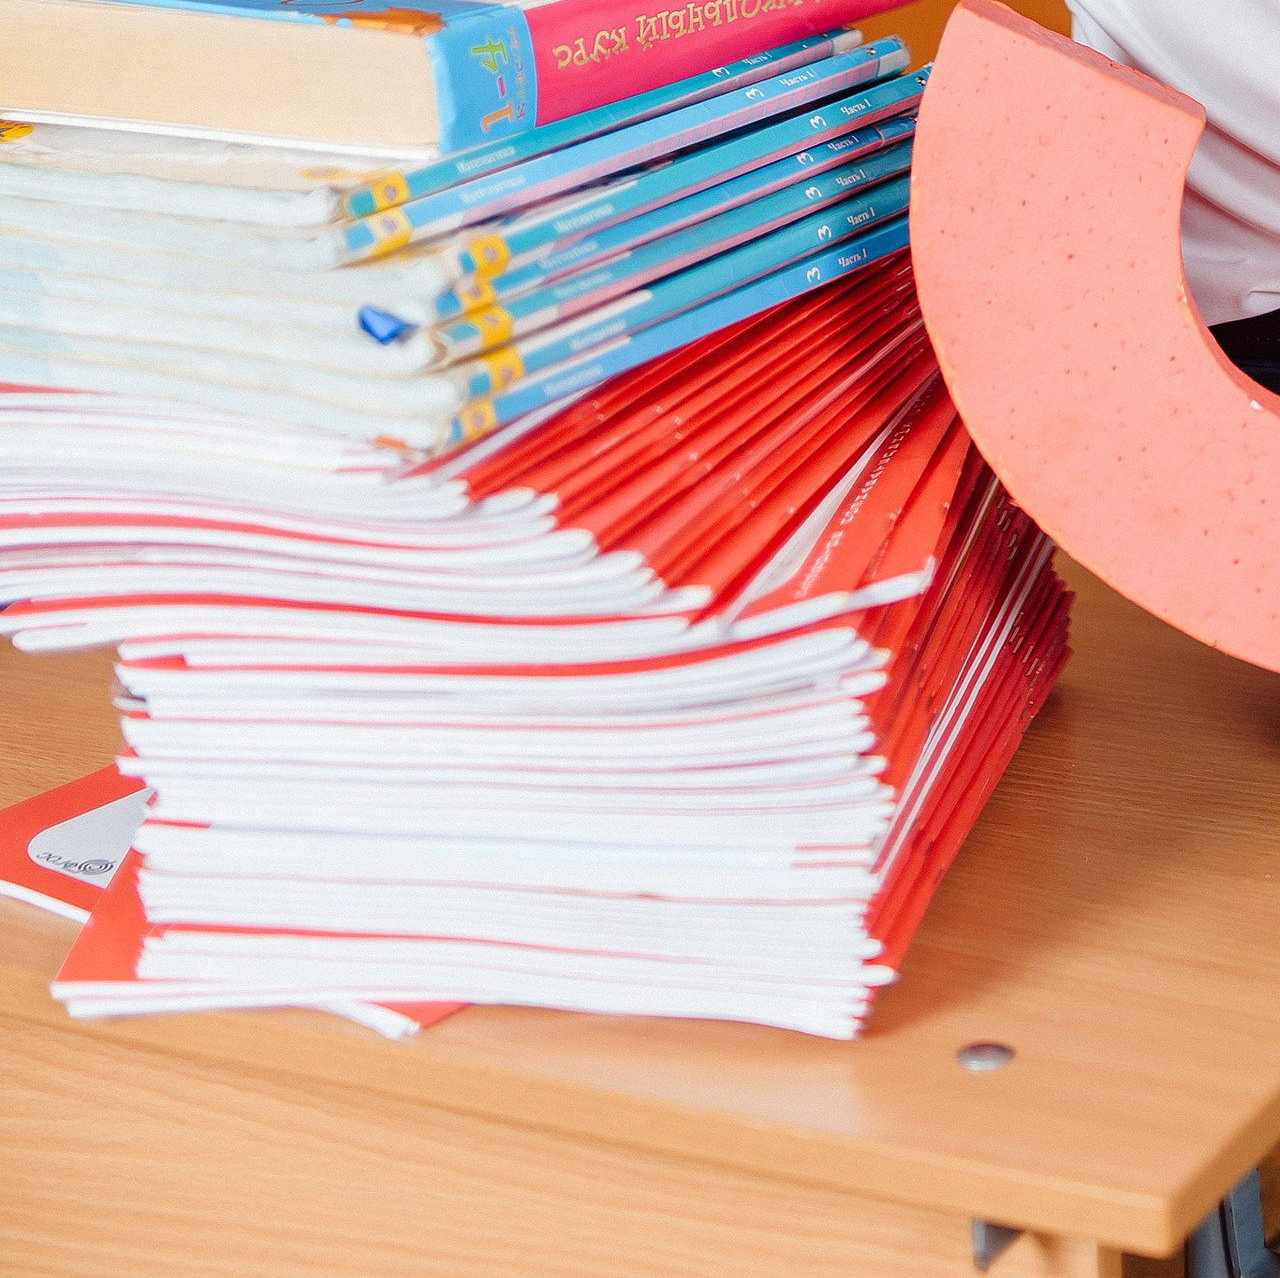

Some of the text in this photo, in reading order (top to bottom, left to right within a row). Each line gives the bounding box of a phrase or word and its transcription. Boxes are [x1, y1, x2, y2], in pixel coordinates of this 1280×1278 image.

[552, 25, 629, 70] КУРС
[780, 73, 808, 87] Часть
[840, 102, 866, 115] Часть
[828, 140, 853, 152] Часть
[836, 173, 861, 187] Часть
[847, 211, 870, 226] Часть
[838, 252, 862, 267] Часть
